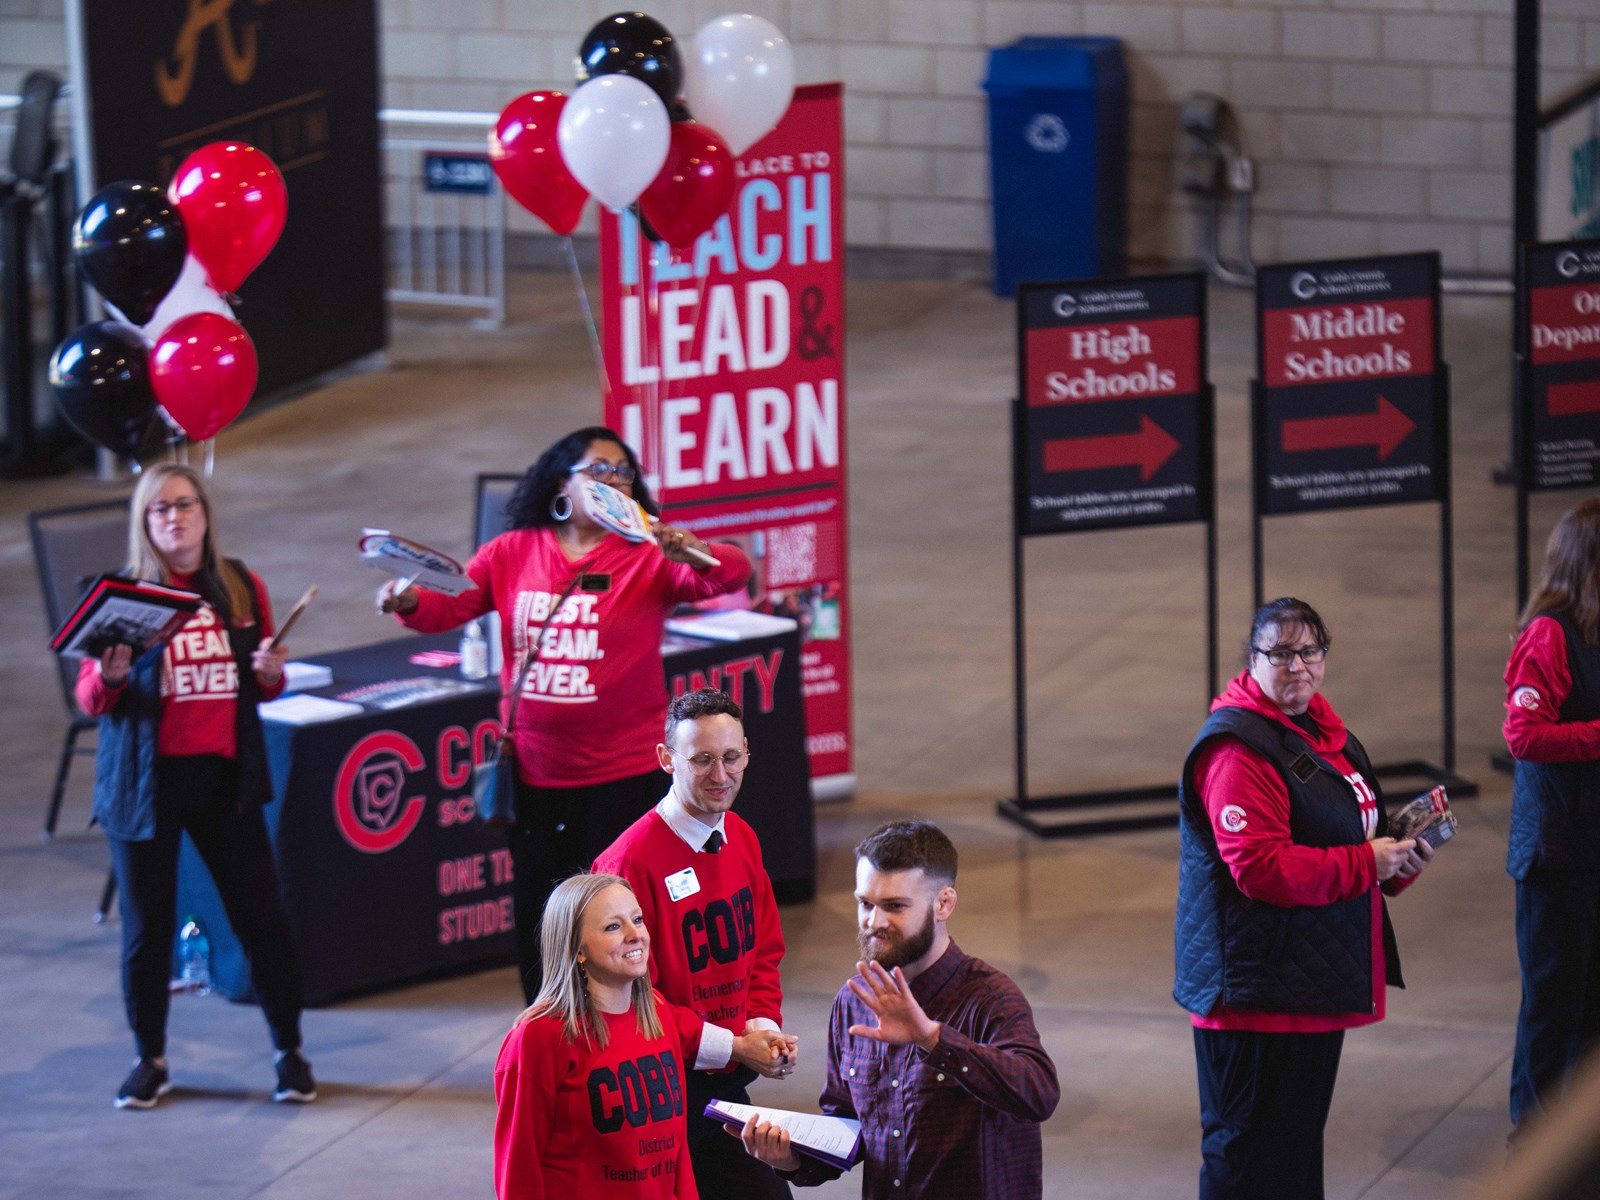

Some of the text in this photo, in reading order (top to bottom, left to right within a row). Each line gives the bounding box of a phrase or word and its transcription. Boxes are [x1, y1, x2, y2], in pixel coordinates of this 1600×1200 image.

[735, 151, 831, 178] LACE TO
[620, 279, 835, 386] LEAD &
[1289, 304, 1406, 342] Middle
[1069, 324, 1152, 364] High
[1283, 342, 1412, 381] Schools
[1045, 361, 1177, 400] Schools
[621, 379, 840, 490] LEARN
[521, 661, 596, 696] EVER.
[437, 853, 487, 897] ONE
[586, 1050, 684, 1135] COBB
[638, 1135, 675, 1157] District
[602, 1164, 649, 1182] Teacher
[651, 1161, 662, 1178] of
